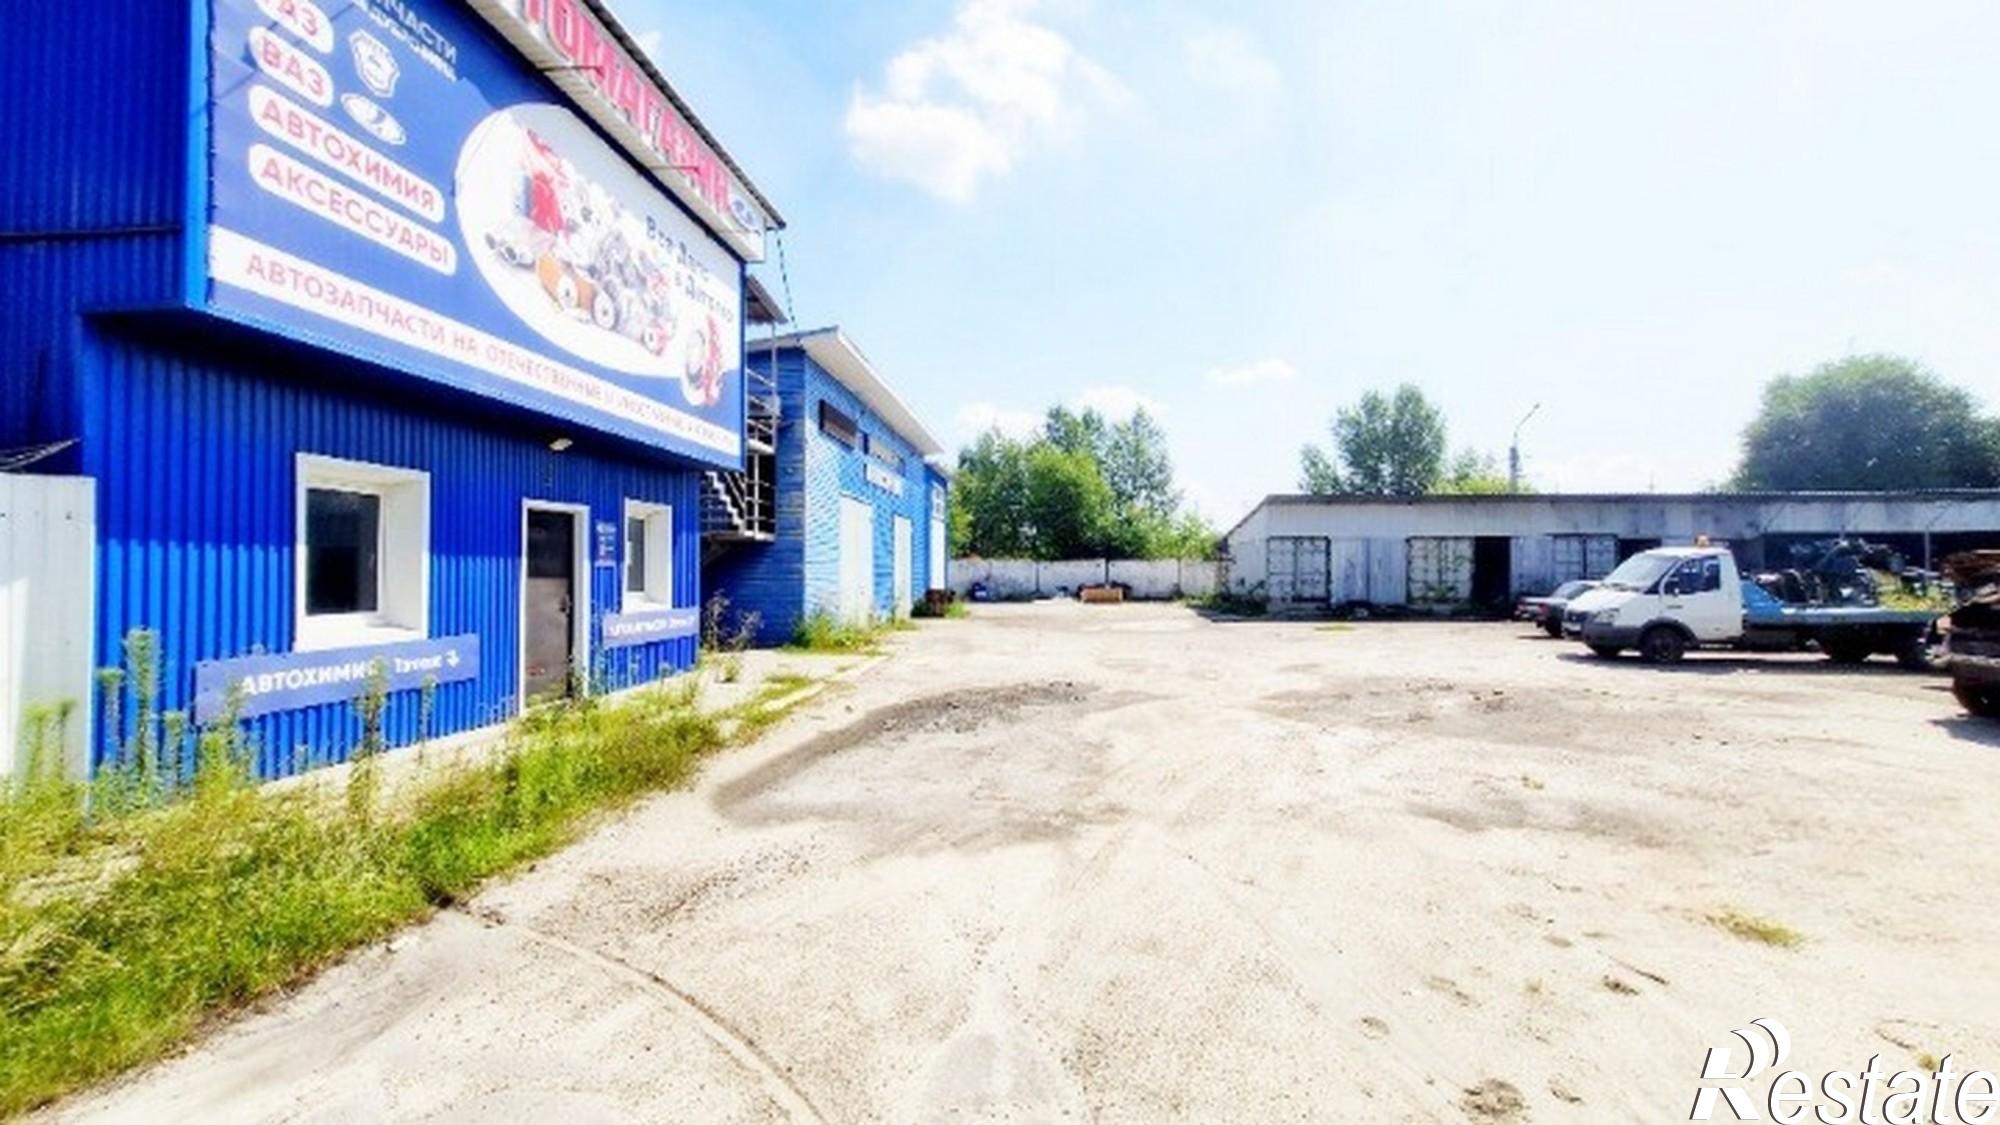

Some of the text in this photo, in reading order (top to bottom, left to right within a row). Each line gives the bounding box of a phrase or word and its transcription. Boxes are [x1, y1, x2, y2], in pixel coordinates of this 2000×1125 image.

[261, 36, 325, 98] ВАЗ
[264, 0, 318, 36] АЗ
[261, 98, 435, 212] АВТОХИМИЯ
[260, 157, 449, 264] АКСЕССУАРЫ
[246, 254, 446, 345] АВТОЗАПЧАСТИ
[454, 332, 477, 352] НА
